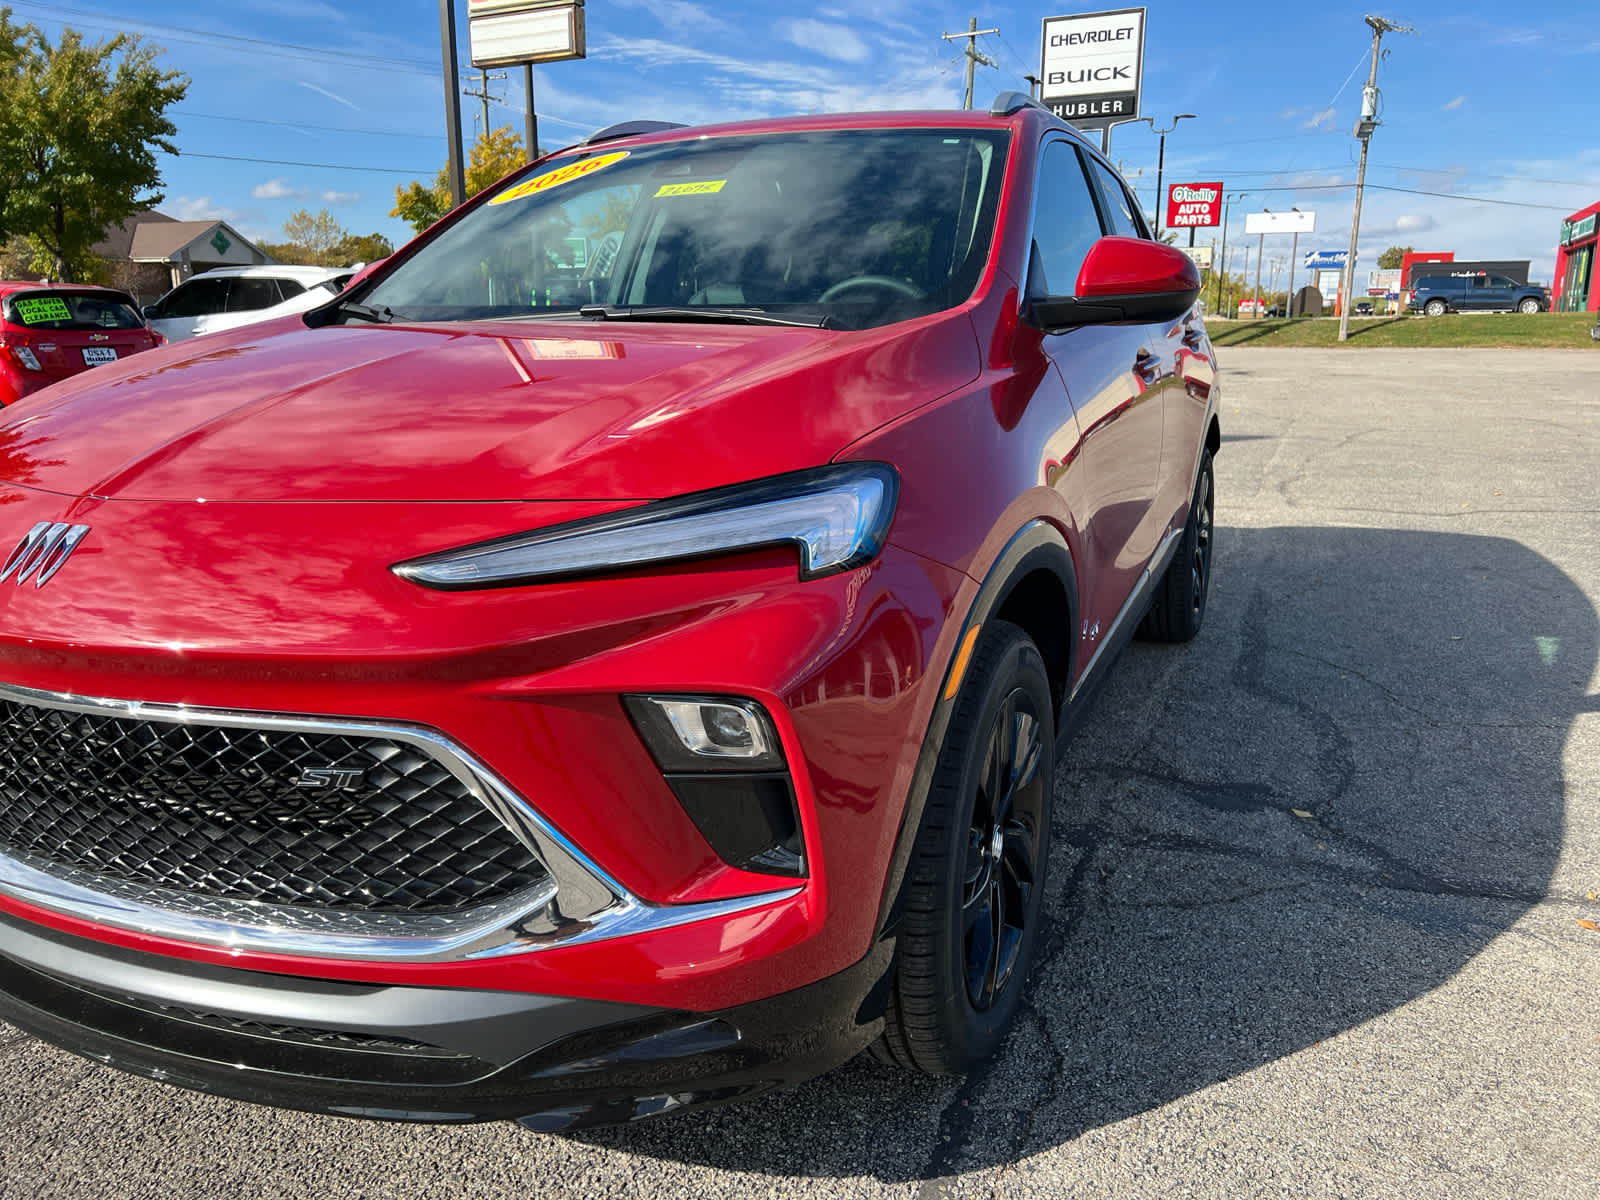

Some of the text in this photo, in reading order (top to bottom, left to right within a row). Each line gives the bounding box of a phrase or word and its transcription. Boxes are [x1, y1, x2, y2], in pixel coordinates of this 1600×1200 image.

[1050, 27, 1134, 47] CHEVROLET
[1048, 65, 1131, 85] BUICK
[1053, 100, 1123, 116] HUBLER
[511, 161, 601, 198] 2026
[1172, 187, 1217, 203] O'Reilly
[1178, 203, 1210, 215] AUTO
[1174, 214, 1211, 225] PARTS
[21, 304, 48, 315] LOCAL
[24, 311, 70, 323] CLEARANCE
[295, 767, 363, 788] ST
